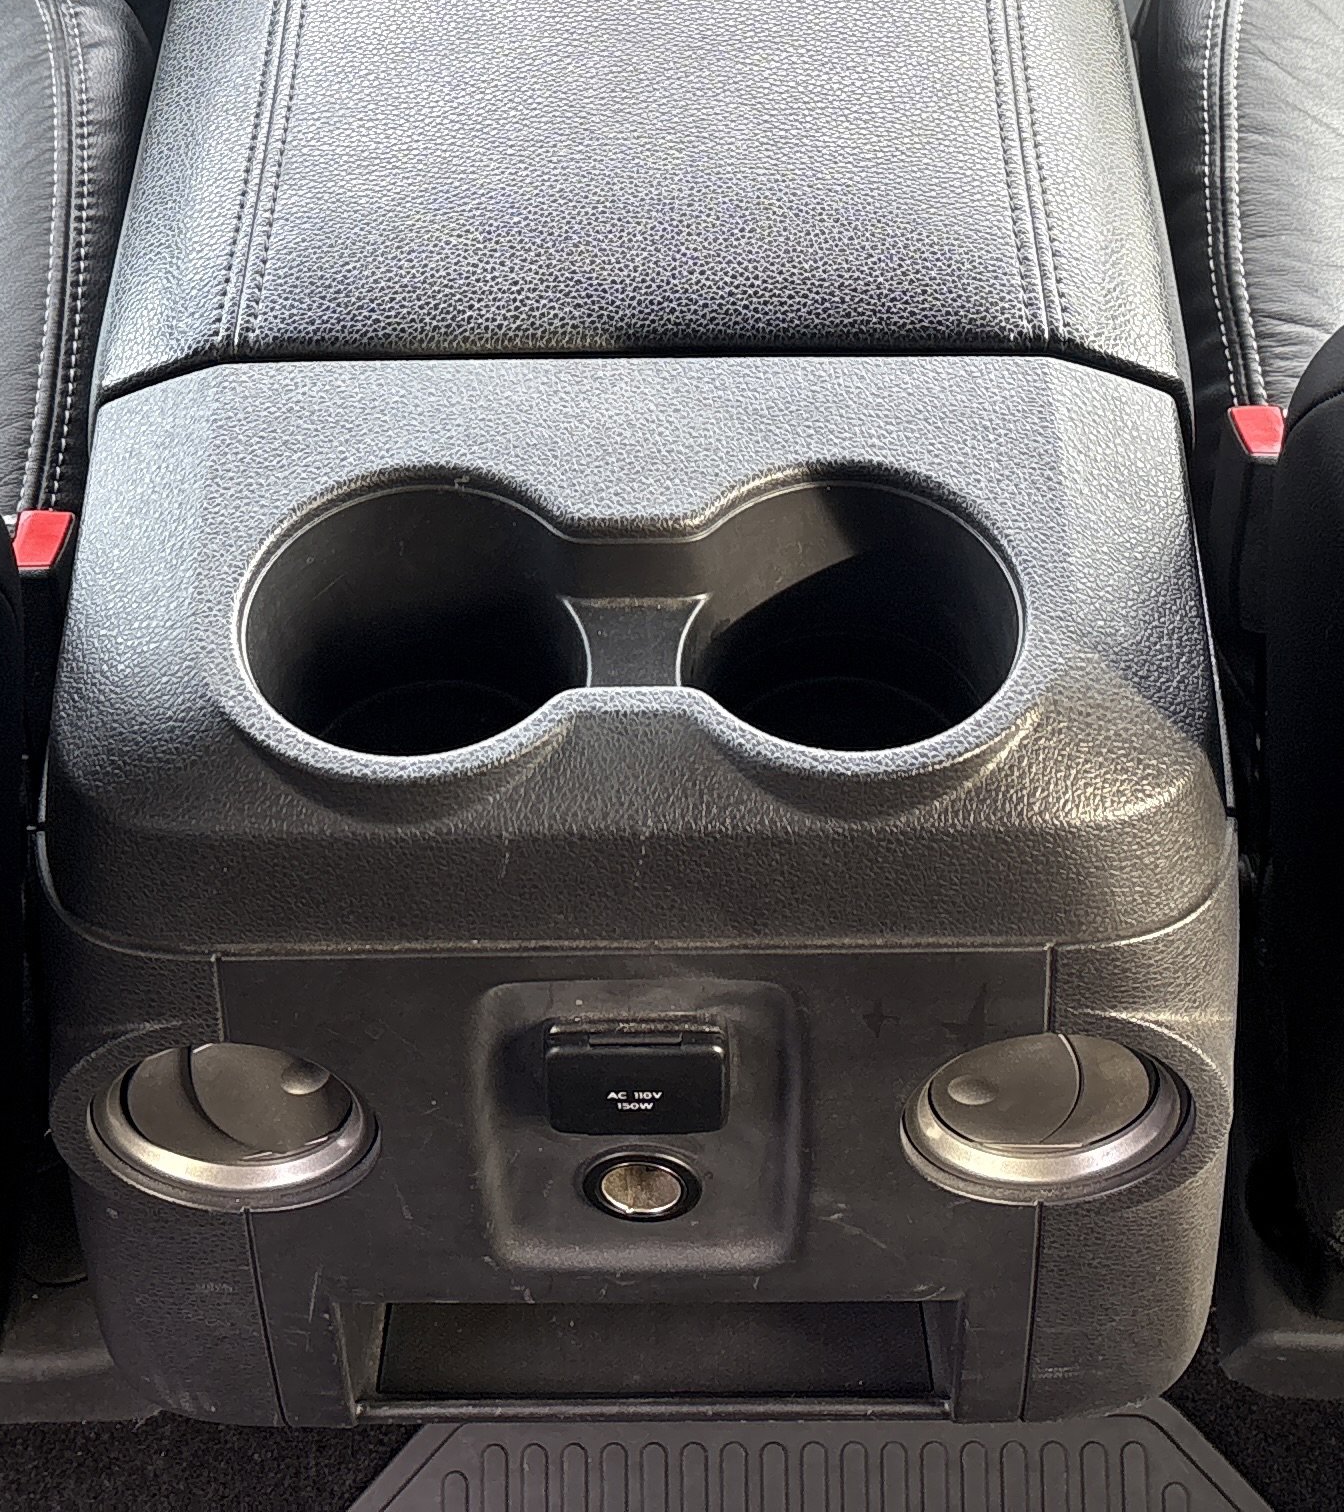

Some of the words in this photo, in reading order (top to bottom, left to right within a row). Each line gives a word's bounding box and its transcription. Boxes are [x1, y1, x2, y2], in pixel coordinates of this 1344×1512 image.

[606, 1091, 627, 1100] AC
[633, 1091, 663, 1100] 110V
[617, 1102, 654, 1111] 150W
